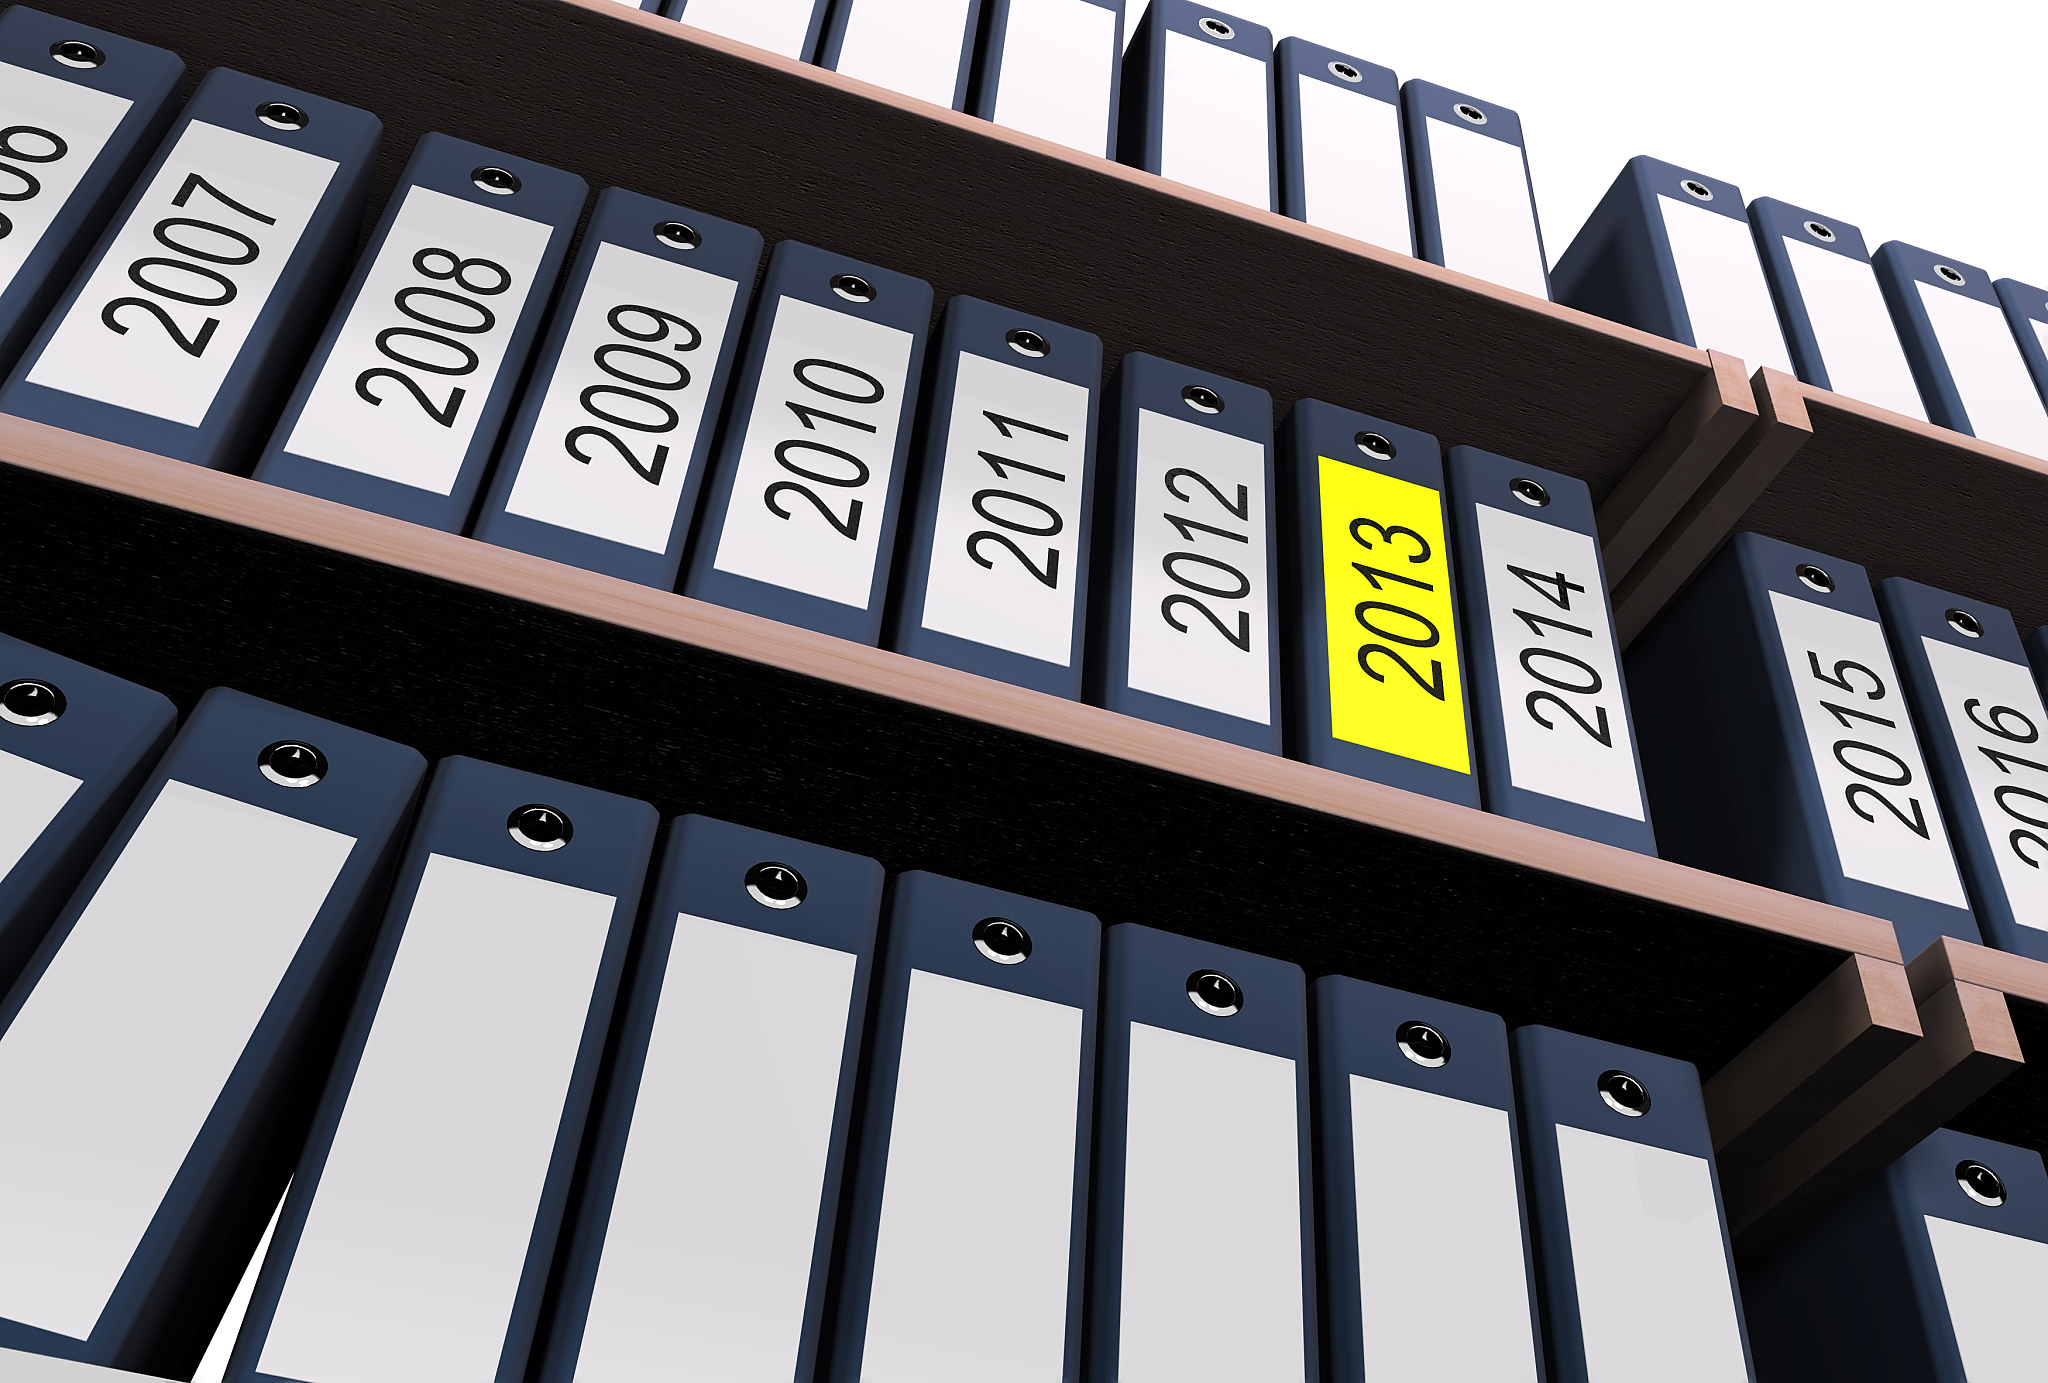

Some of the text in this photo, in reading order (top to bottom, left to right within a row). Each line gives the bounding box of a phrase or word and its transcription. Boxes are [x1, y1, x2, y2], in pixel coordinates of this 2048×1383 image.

[102, 173, 276, 358] 2007
[355, 248, 511, 428] 2008
[565, 305, 701, 485] 2009
[764, 359, 884, 540] 2010
[967, 410, 1068, 589] 2011
[1161, 468, 1250, 652] 2012
[1350, 518, 1445, 701] 2013
[1507, 564, 1612, 748] 2014
[1807, 651, 1930, 840] 2015
